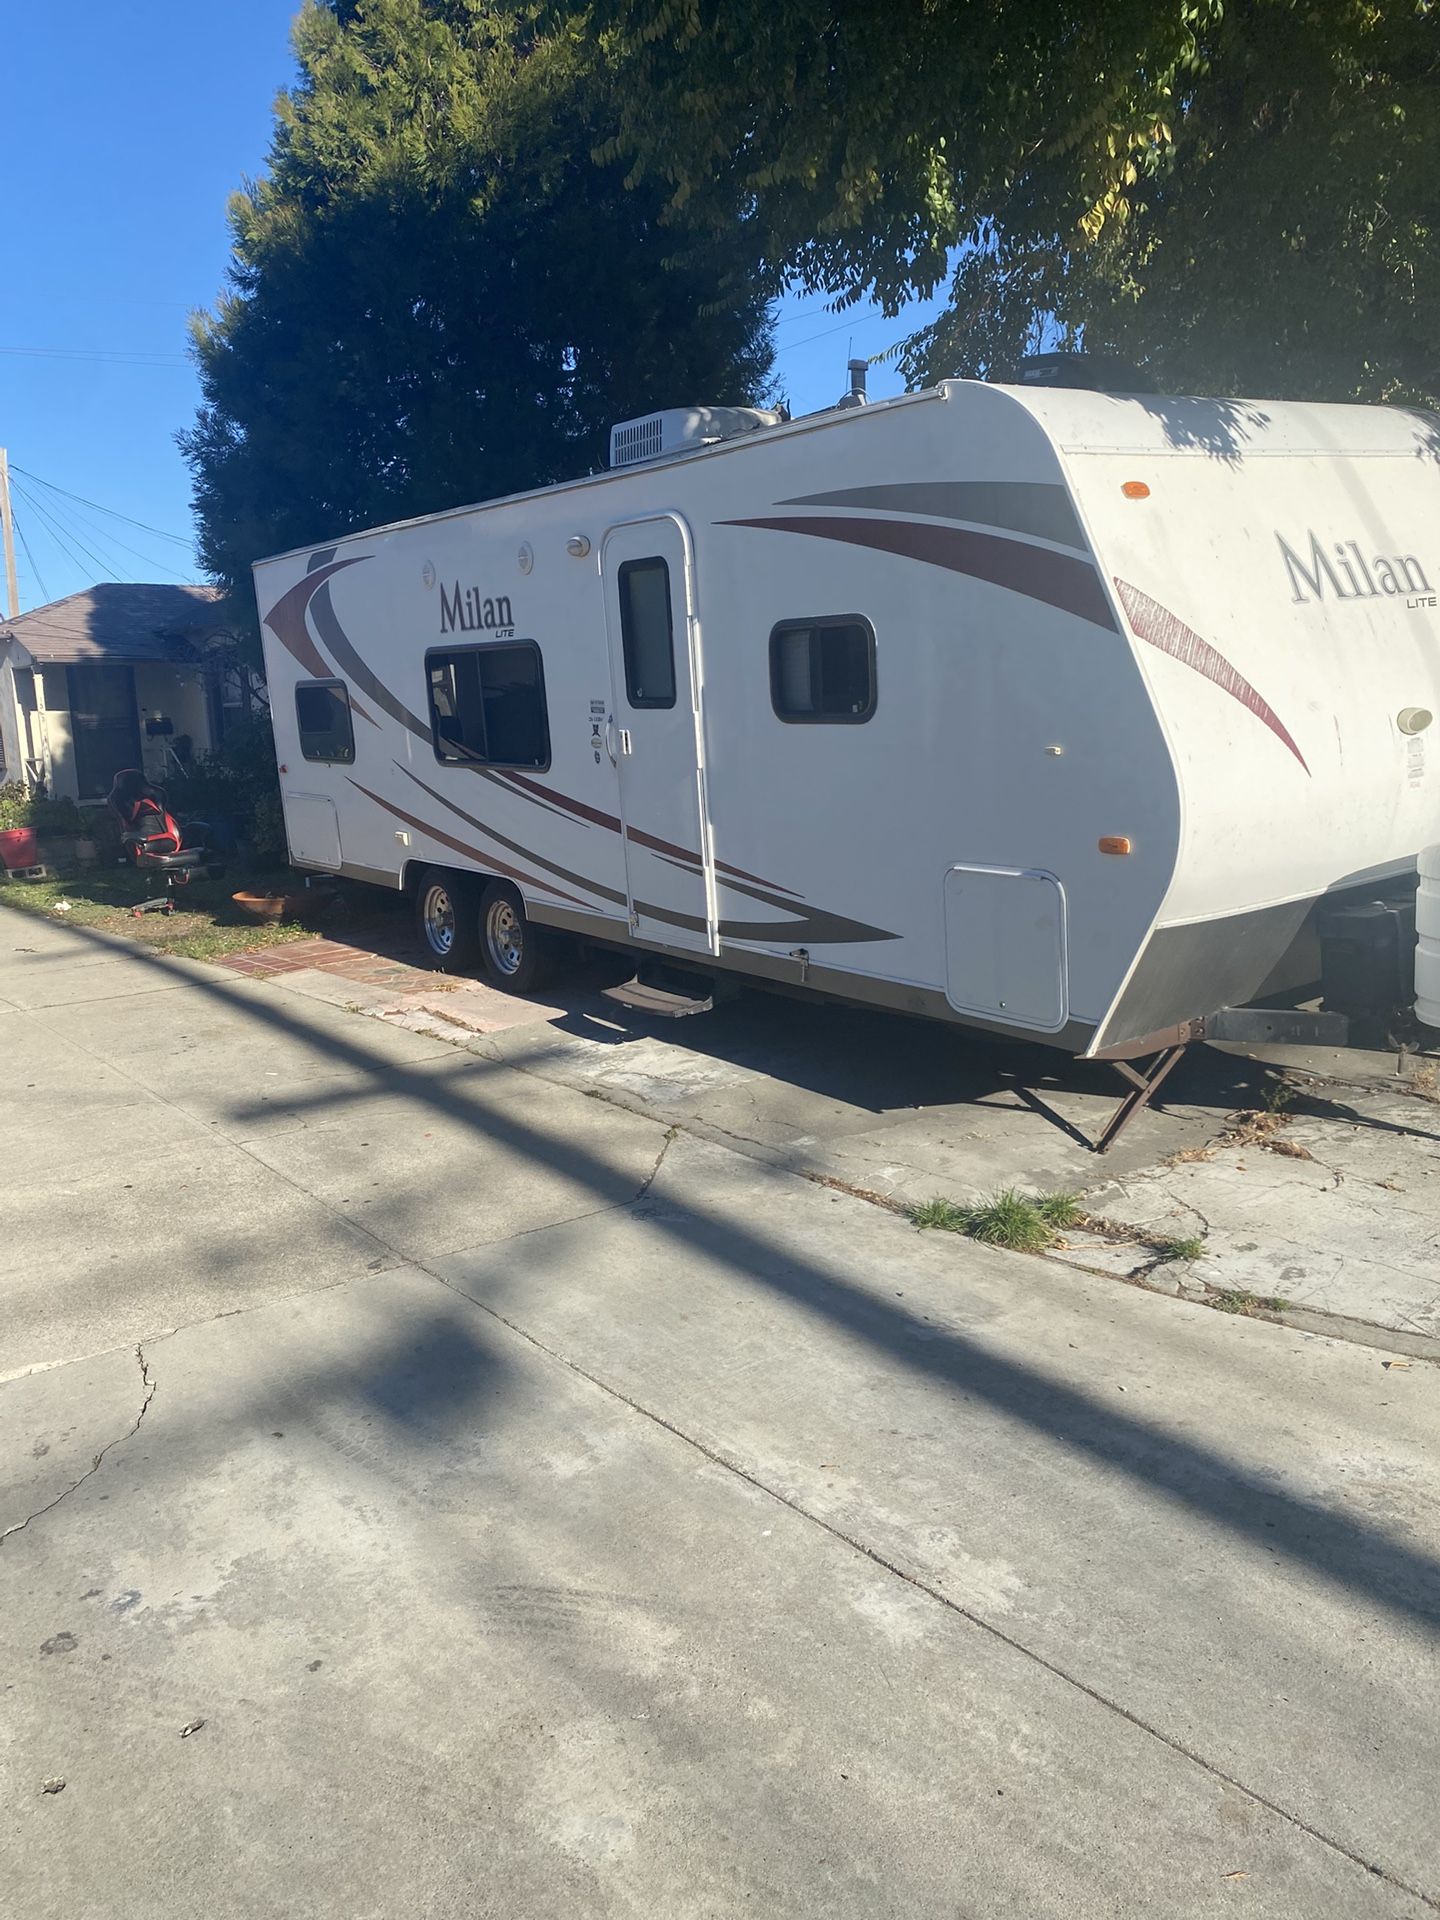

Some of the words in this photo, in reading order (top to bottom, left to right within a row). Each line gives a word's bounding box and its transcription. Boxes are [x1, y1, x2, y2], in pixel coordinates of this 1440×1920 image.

[1274, 528, 1435, 603] Milan
[440, 579, 515, 633] Milan
[1406, 597, 1437, 609] LITE
[495, 629, 514, 638] LITE
